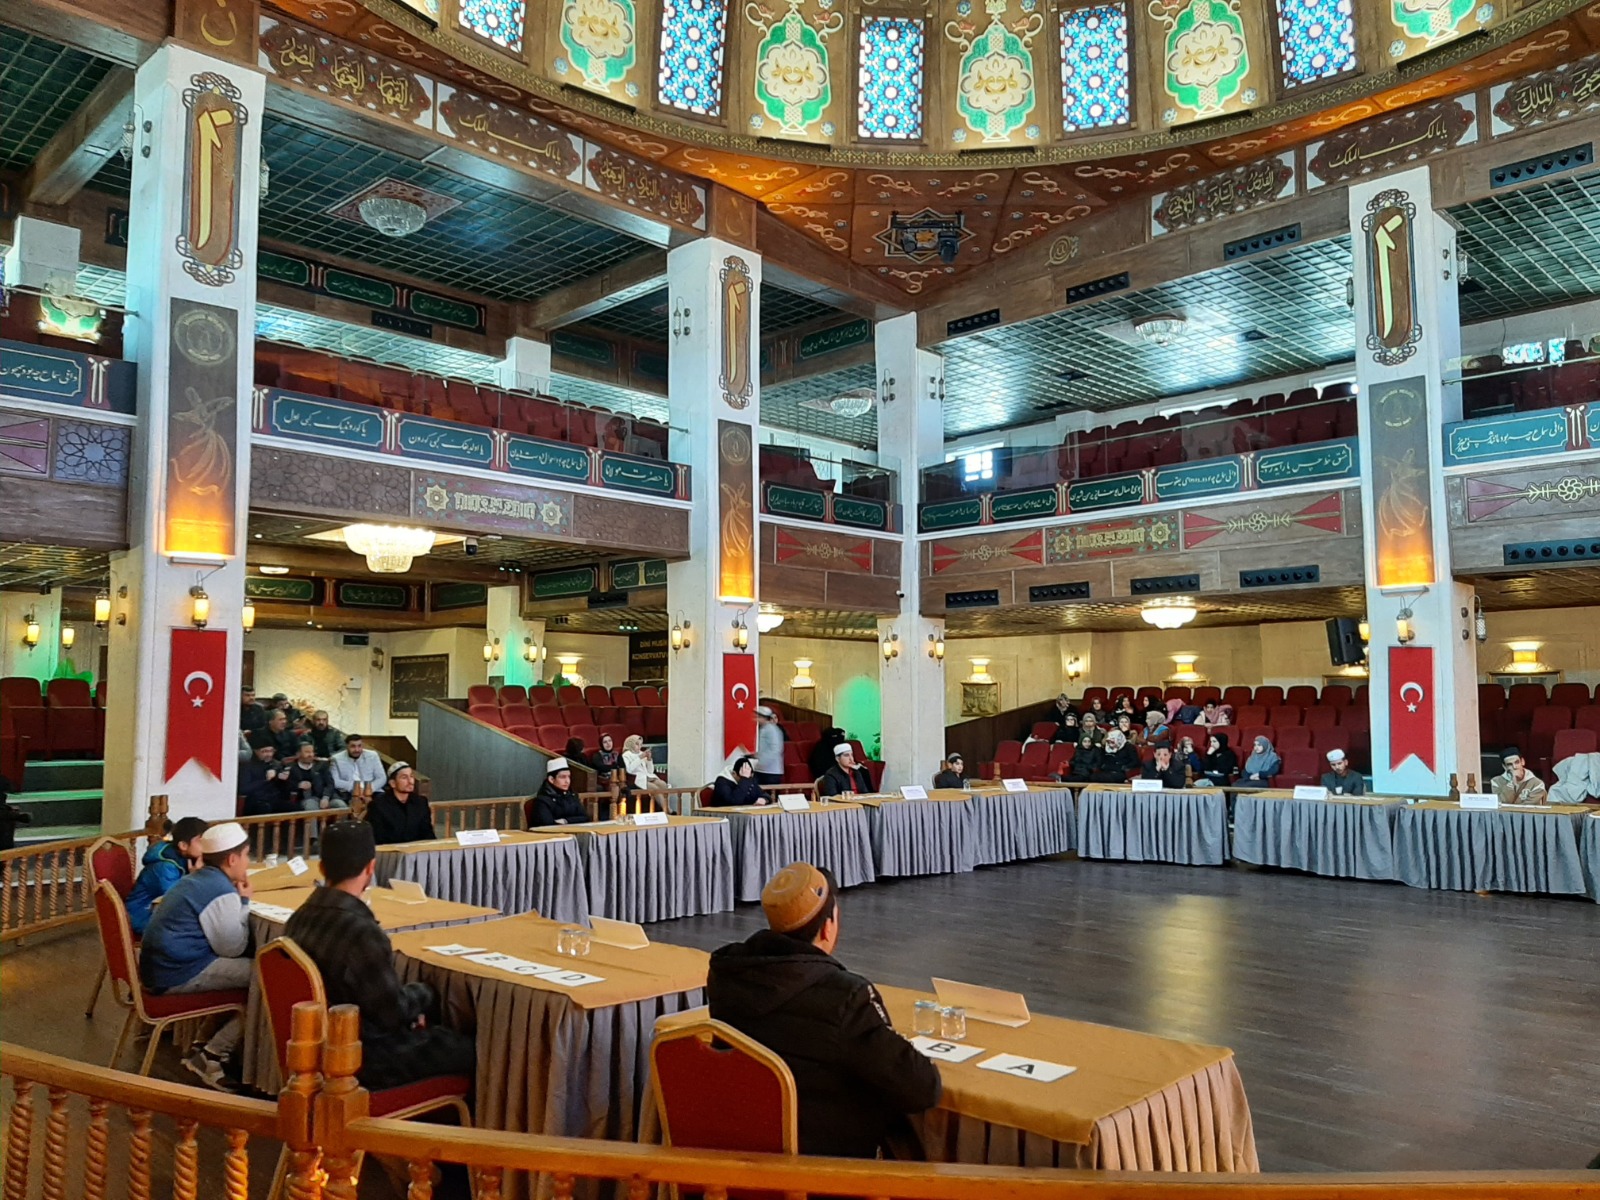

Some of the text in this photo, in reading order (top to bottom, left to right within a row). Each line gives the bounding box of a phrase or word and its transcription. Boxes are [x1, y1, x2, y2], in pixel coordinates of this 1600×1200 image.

[560, 974, 587, 982] D
[926, 1042, 957, 1053] B
[1006, 1063, 1035, 1075] A
